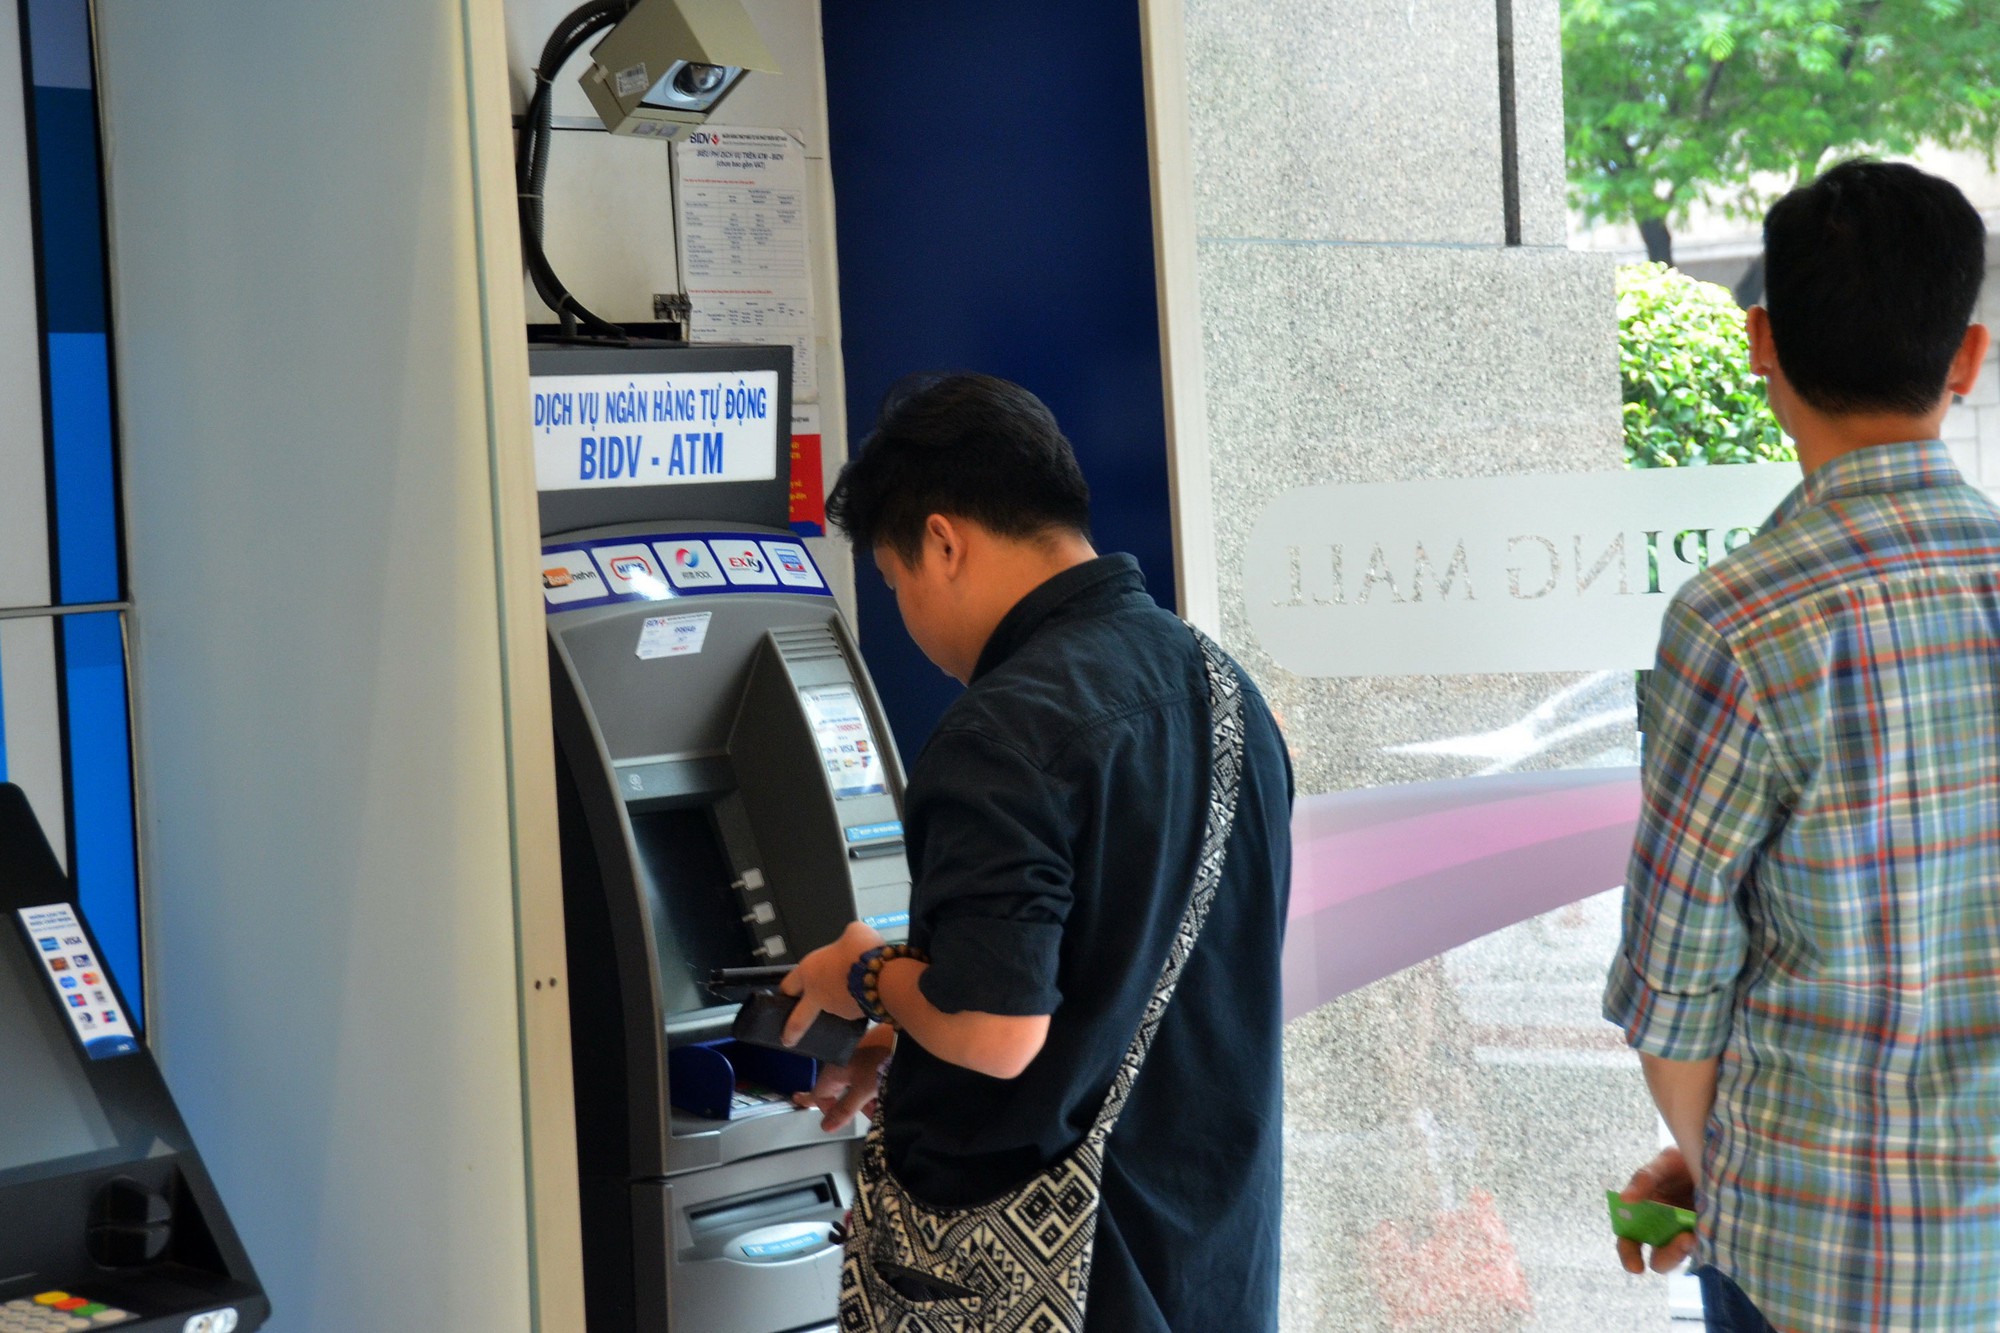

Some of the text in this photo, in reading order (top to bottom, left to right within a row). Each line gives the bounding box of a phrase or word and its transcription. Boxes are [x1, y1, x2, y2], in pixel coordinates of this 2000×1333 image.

[535, 379, 767, 434] DỊCH VỤ NGÂN HÀNG TỰ ĐỘNG
[579, 435, 642, 480] BIDV
[668, 432, 724, 476] ATM
